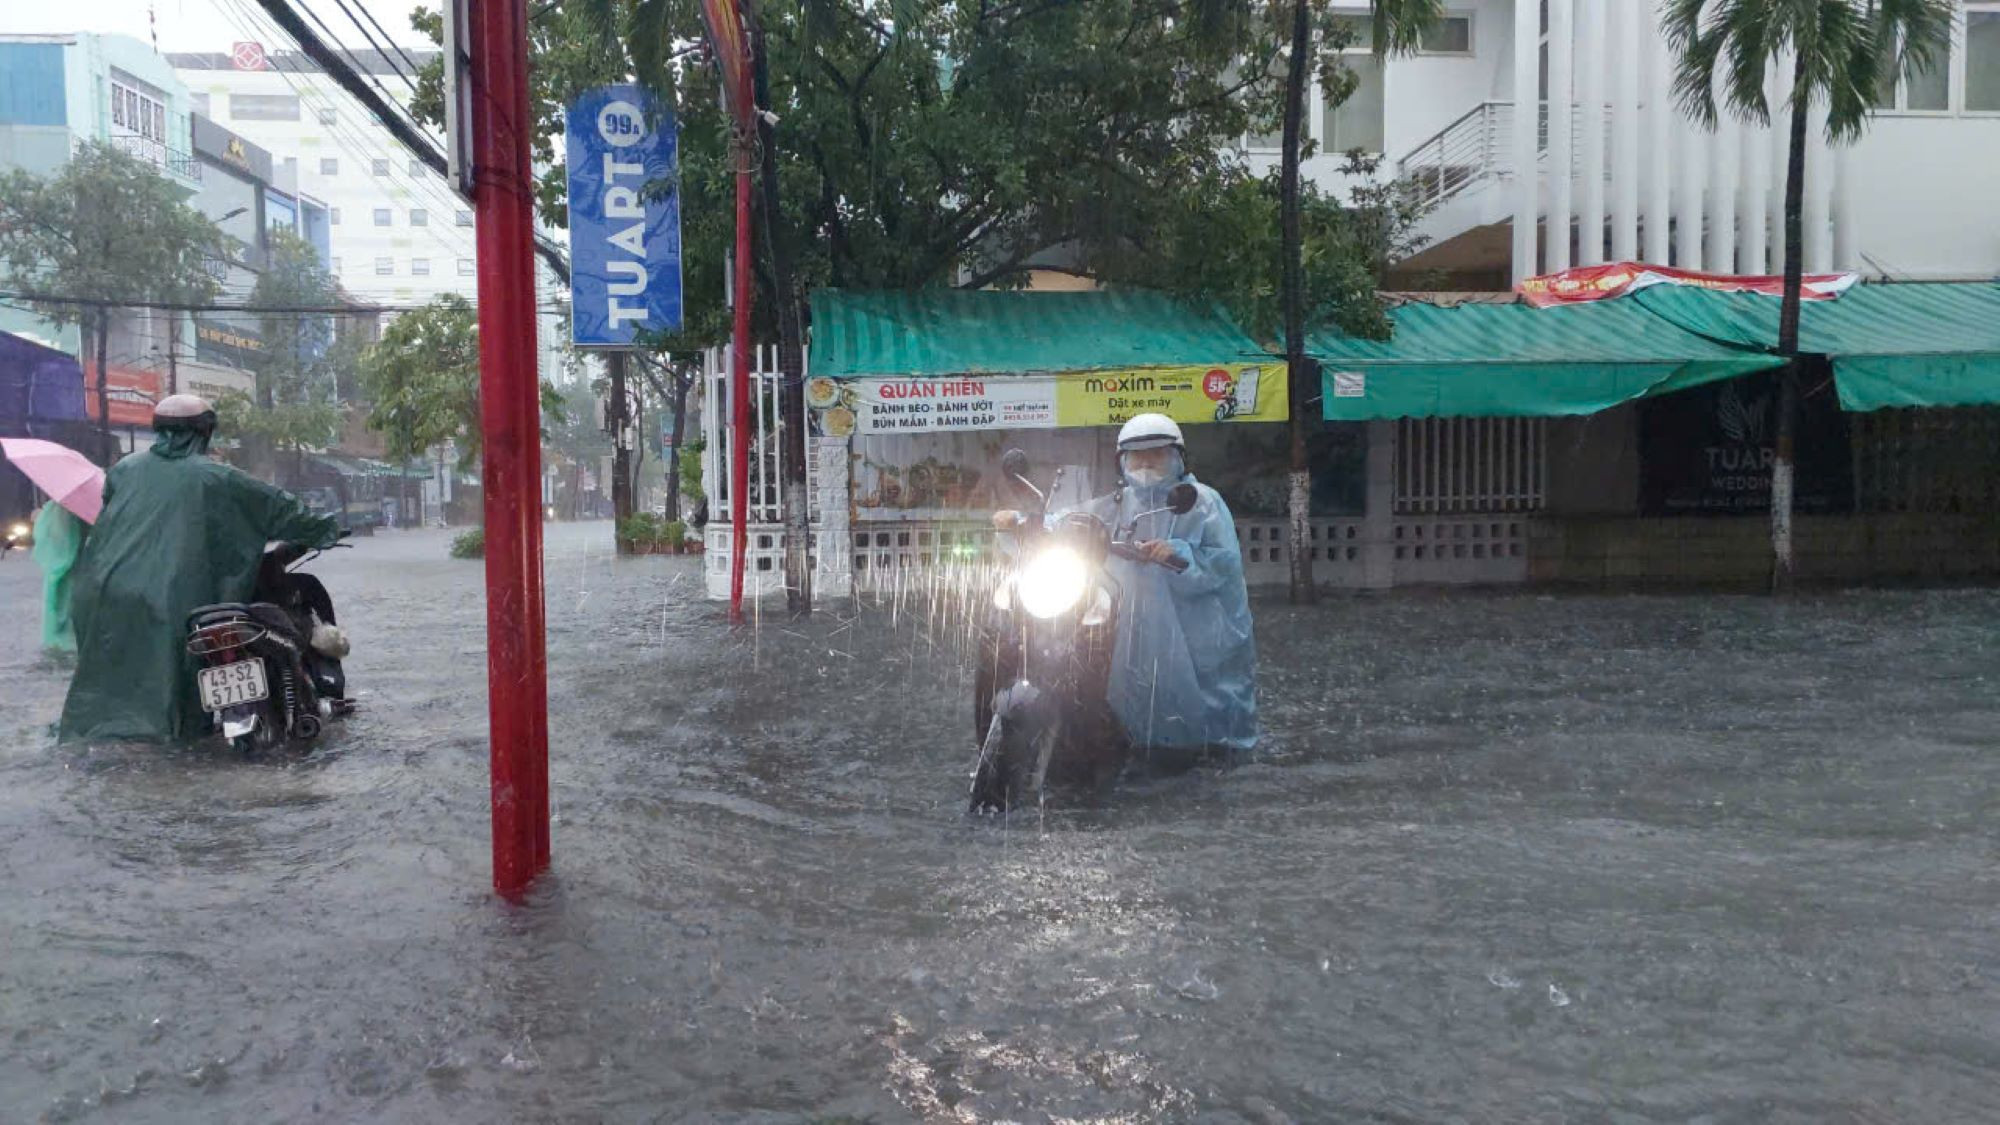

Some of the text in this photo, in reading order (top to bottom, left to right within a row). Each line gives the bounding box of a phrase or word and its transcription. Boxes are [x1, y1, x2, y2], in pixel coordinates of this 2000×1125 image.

[603, 152, 649, 330] TUART
[879, 379, 936, 399] QUÁN
[1085, 373, 1155, 393] maxim
[872, 402, 905, 415] BÁNH
[937, 402, 969, 413] BÁNH
[1132, 400, 1144, 409] xe
[1148, 397, 1171, 410] máy
[872, 416, 896, 429] BÚN
[937, 415, 969, 427] BÁNH
[1704, 447, 1776, 470] TUAR
[1711, 476, 1774, 491] WEDDIN
[211, 681, 258, 705] 5719
